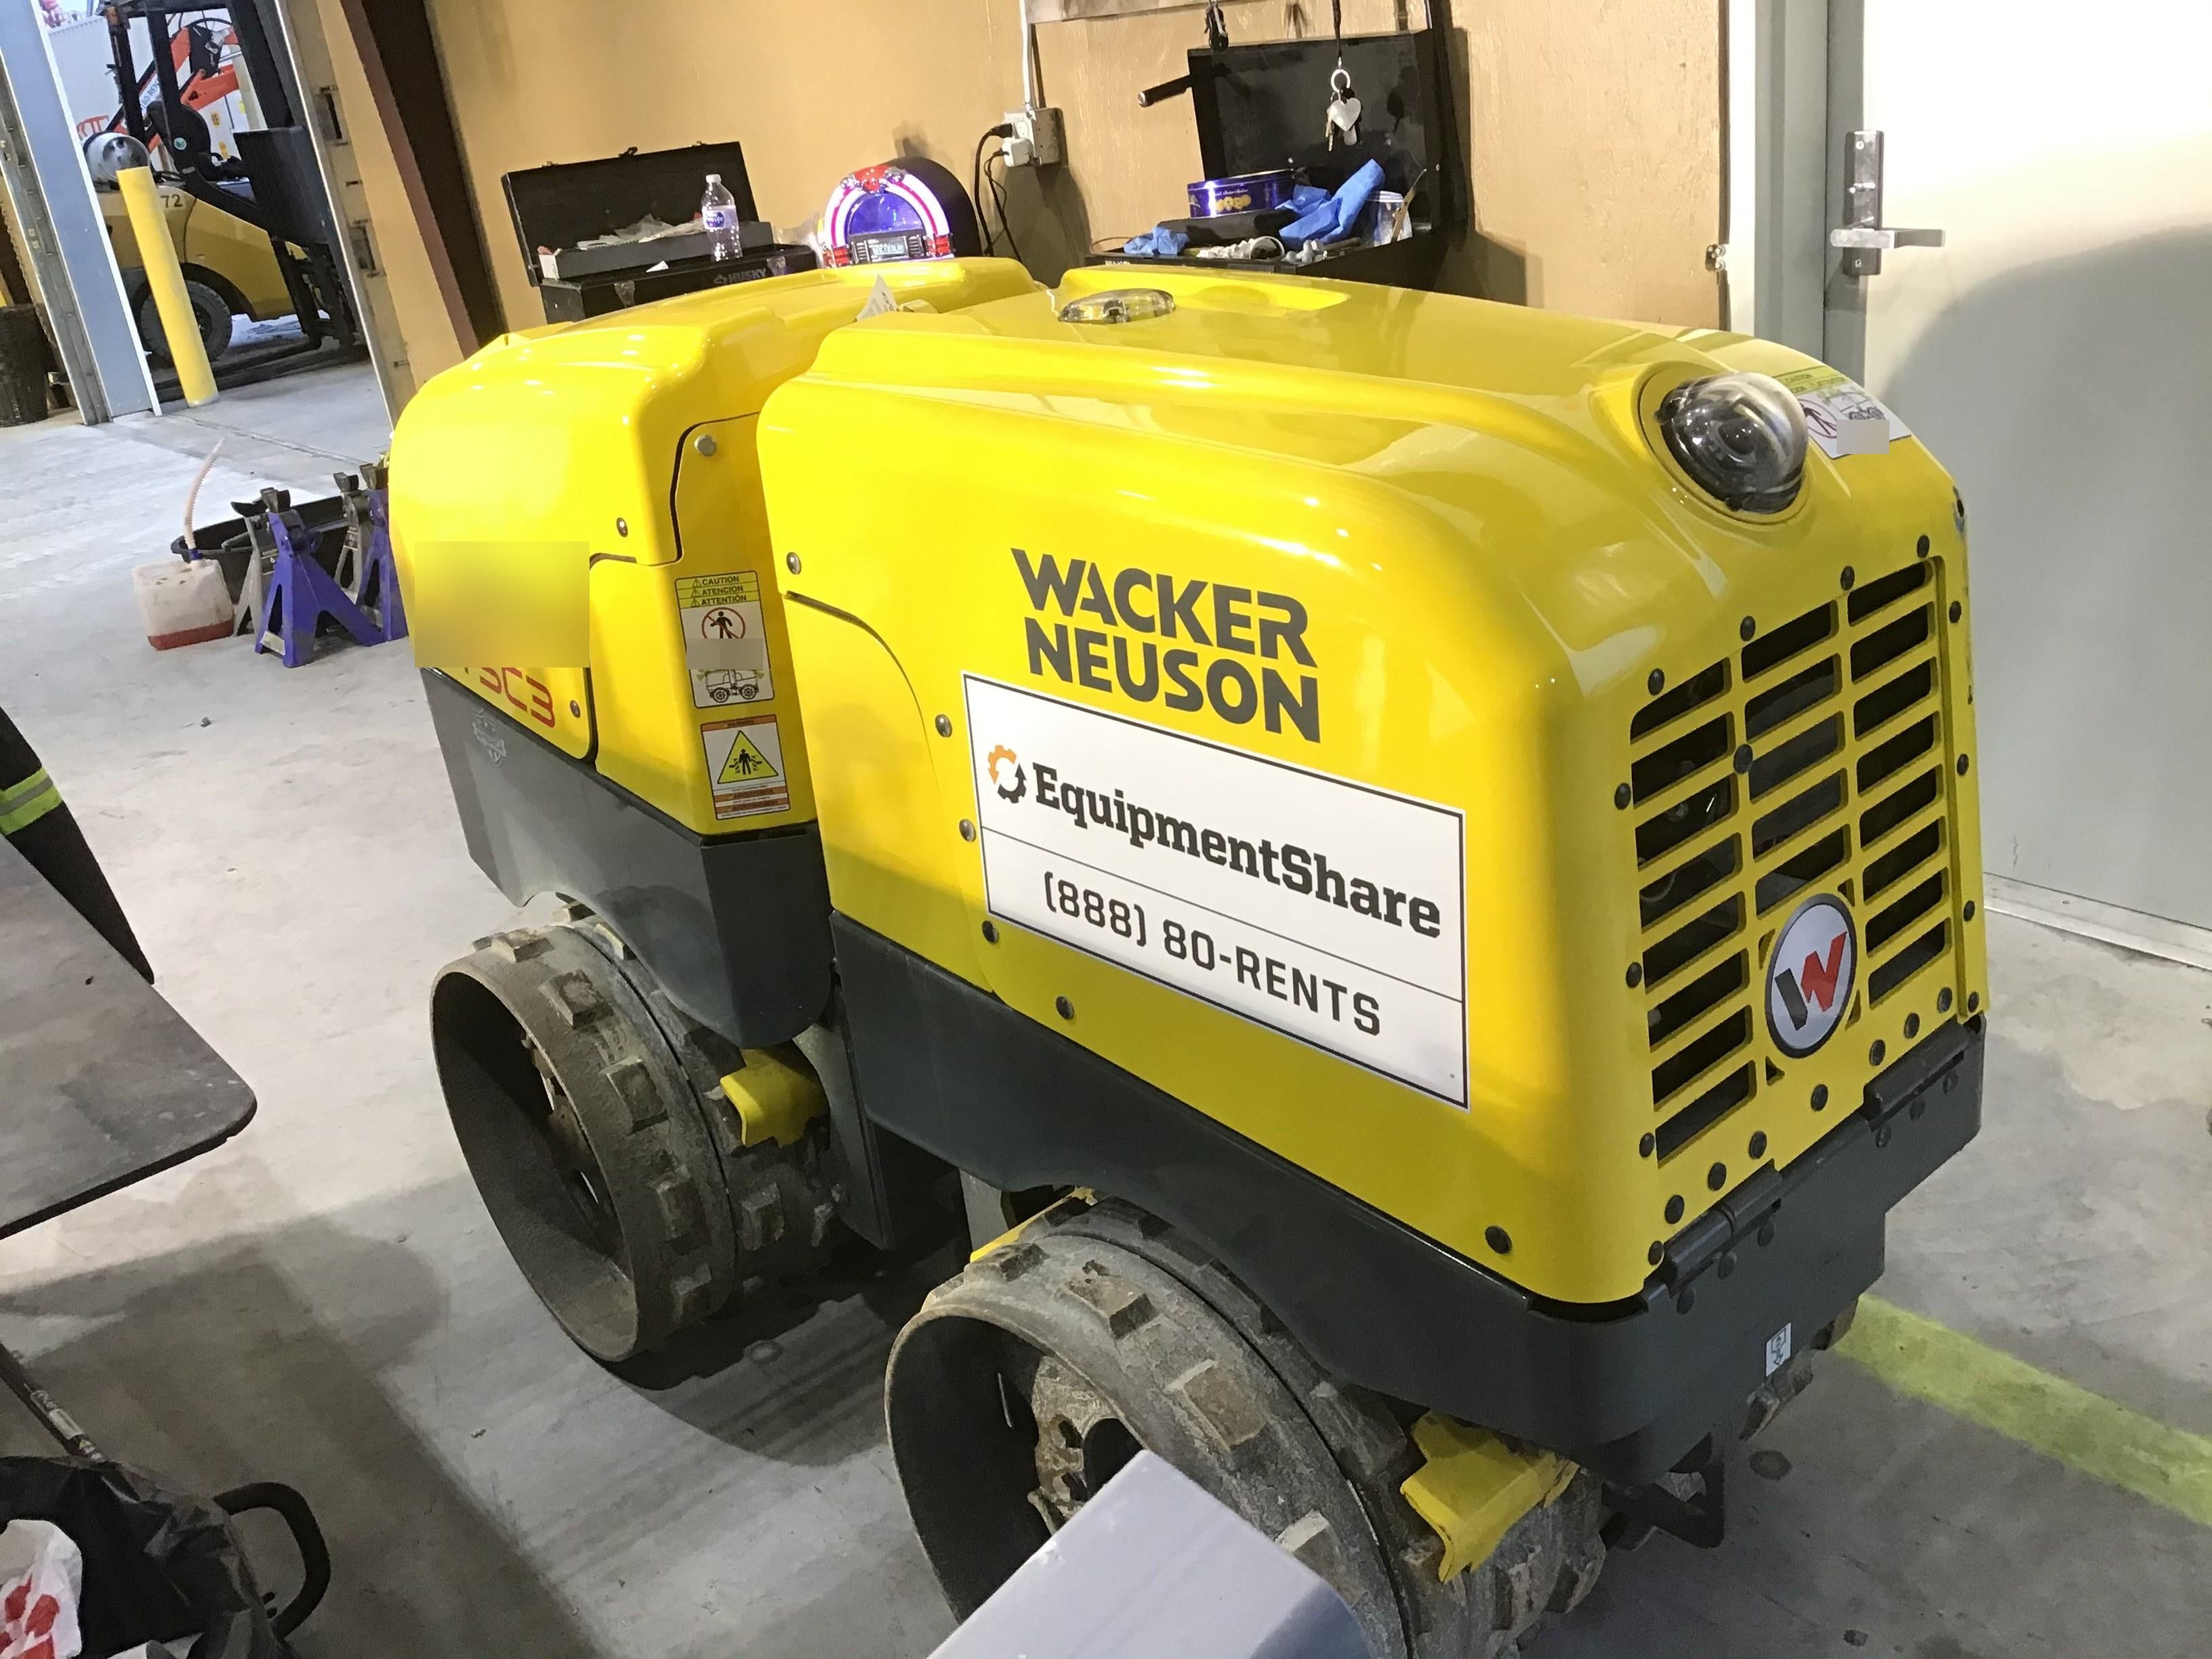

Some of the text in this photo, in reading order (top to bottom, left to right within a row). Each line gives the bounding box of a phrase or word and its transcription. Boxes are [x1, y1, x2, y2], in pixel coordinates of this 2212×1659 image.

[161, 194, 183, 208] 72
[701, 585, 743, 596] ATENCION
[701, 594, 747, 606] ATTENTION
[702, 575, 739, 586] CAUTION
[1010, 548, 1318, 669] WACKER
[1025, 617, 1321, 743] NEUSON
[1033, 761, 1441, 939] EquipmentShare
[1044, 871, 1380, 1037] (888) 80-RENTS
